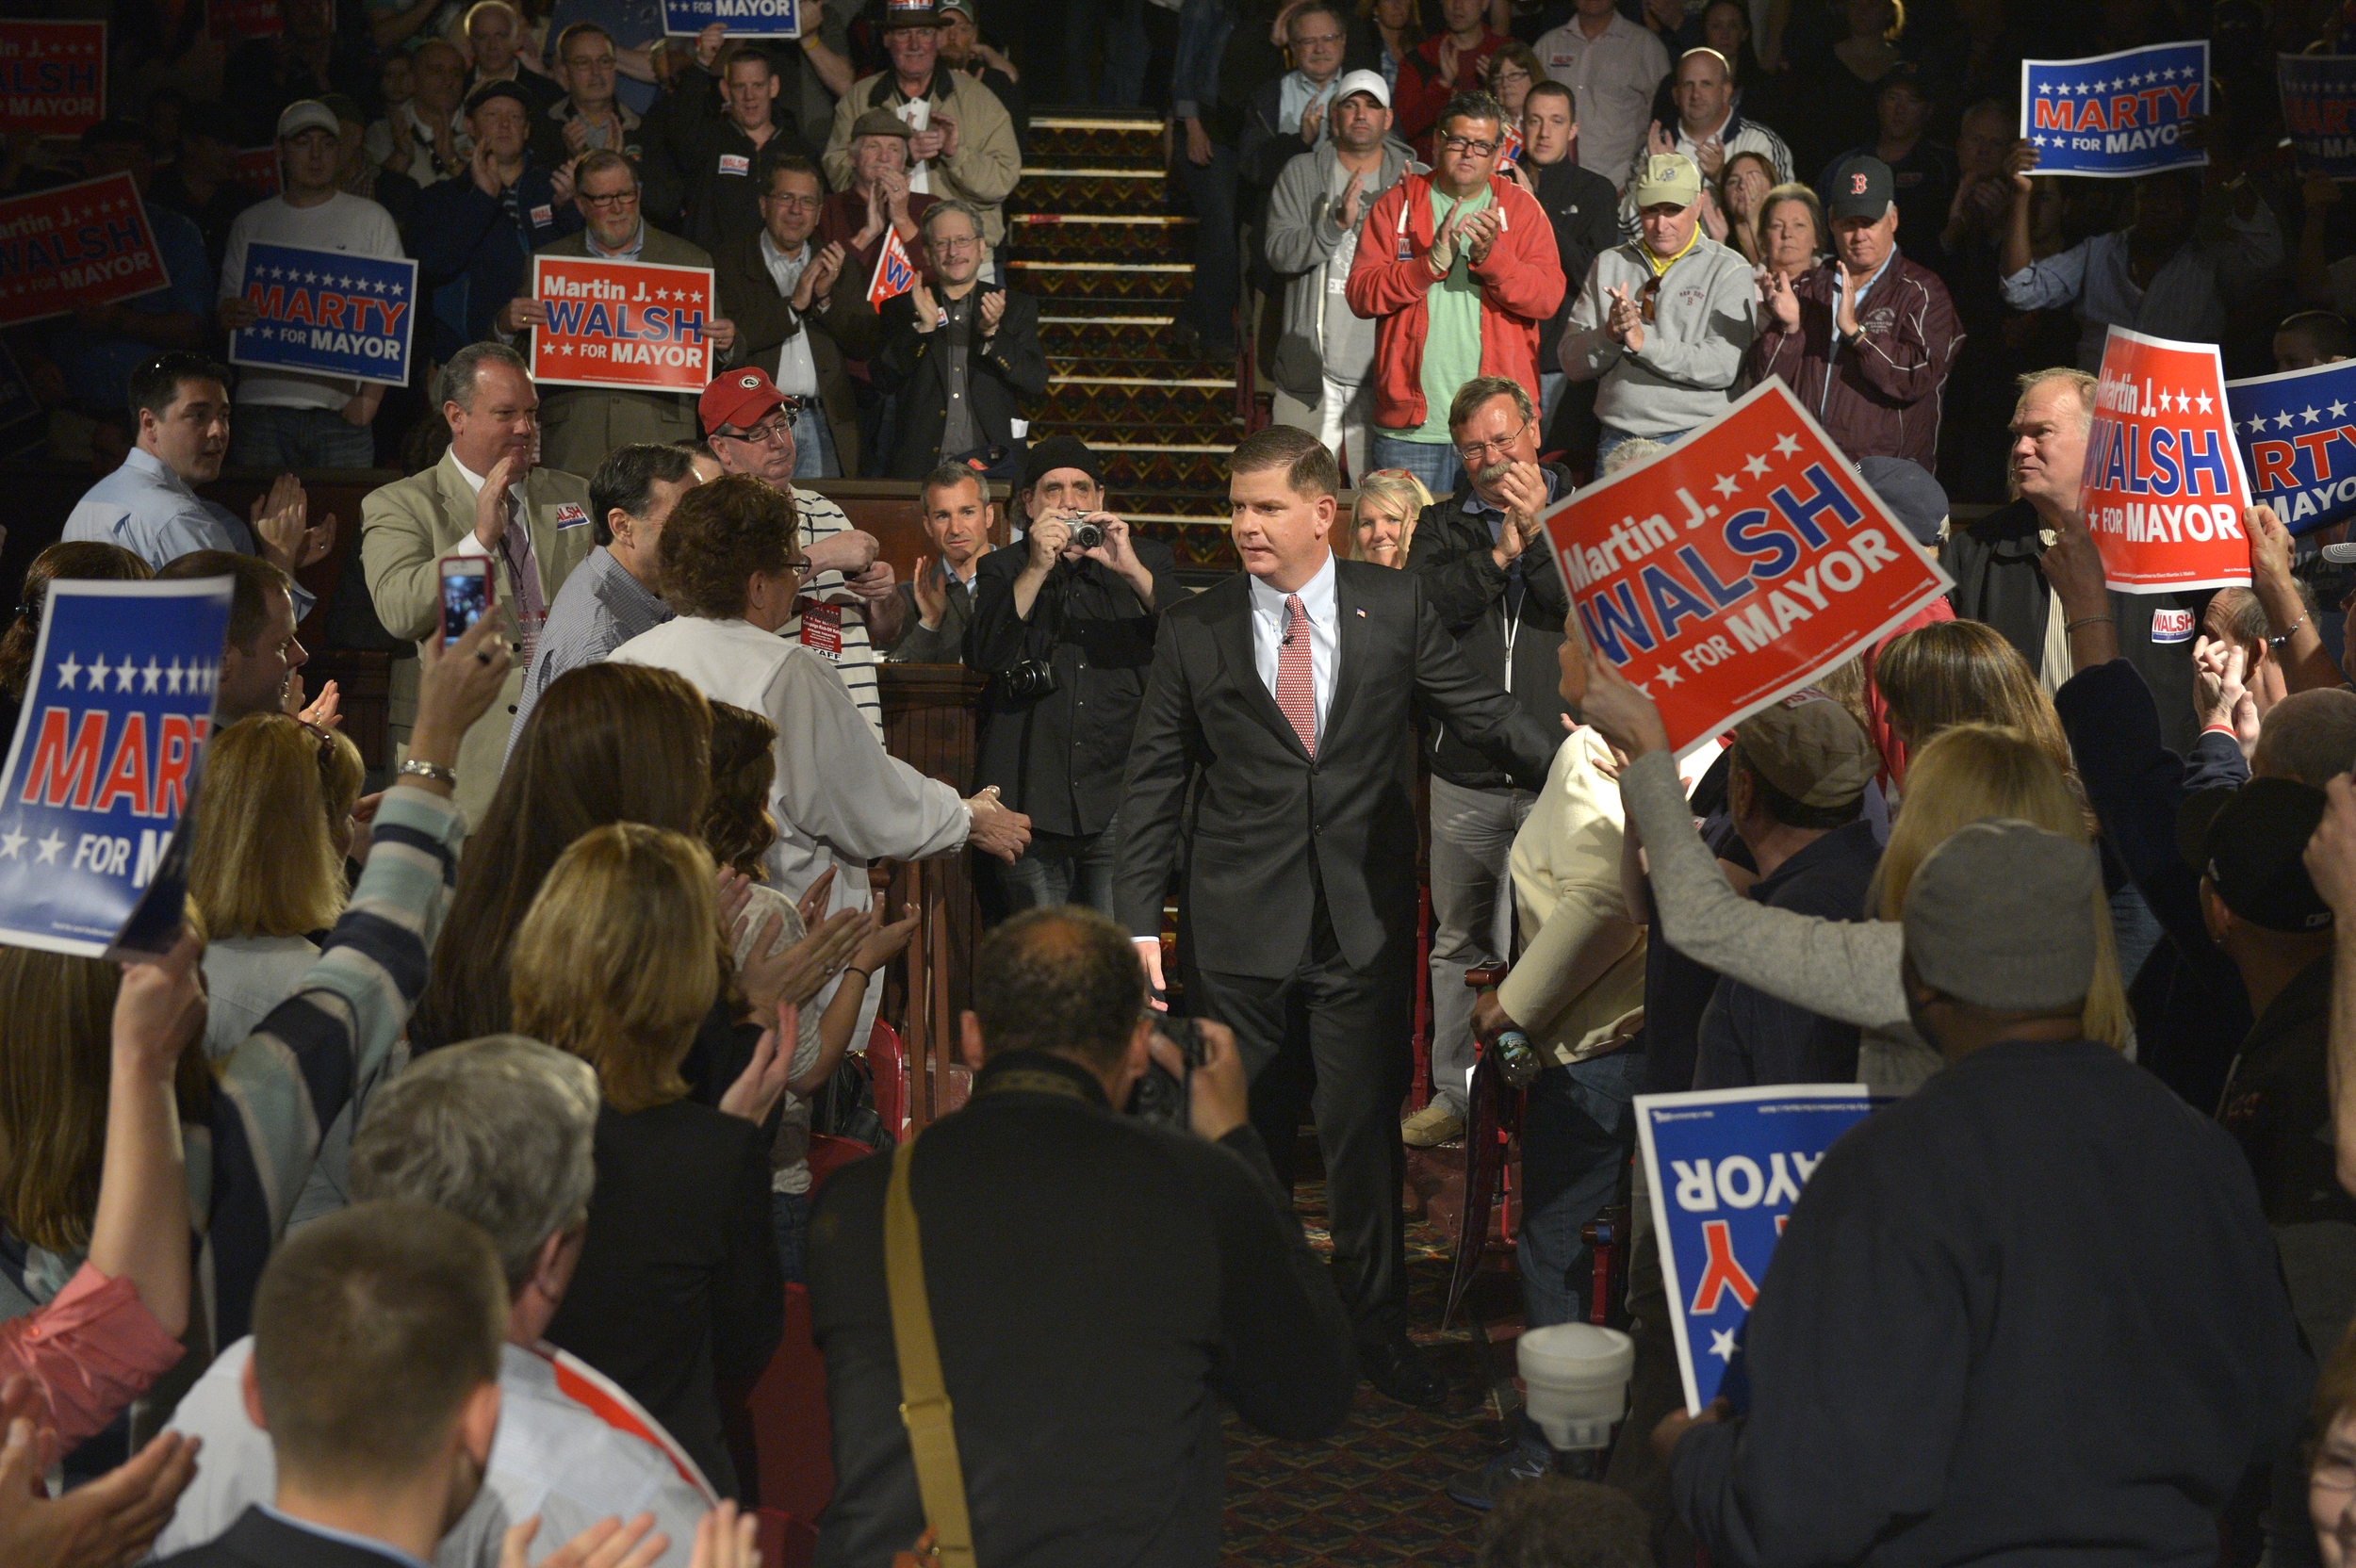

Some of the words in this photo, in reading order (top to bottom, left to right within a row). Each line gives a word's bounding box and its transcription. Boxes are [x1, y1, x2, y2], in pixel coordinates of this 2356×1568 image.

[690, 1, 713, 14] FOR
[715, 0, 791, 17] MAYOR
[8, 96, 95, 116] MAYOR
[2034, 83, 2201, 132] MARTY
[2071, 137, 2102, 152] FOR
[1851, 173, 1868, 195] B
[59, 250, 154, 290] MAYOR
[544, 274, 627, 301] Martin
[631, 281, 652, 303] J.
[249, 282, 408, 337] MARTY
[542, 299, 705, 345] WALSH
[280, 326, 307, 346] FOR
[310, 328, 402, 362] MAYOR
[580, 343, 608, 358] FOR
[612, 342, 703, 368] MAYOR
[2096, 368, 2139, 415] Martin
[2140, 377, 2157, 417] J.
[2084, 417, 2232, 498] WALSH
[1562, 513, 1678, 593] Martin
[1675, 486, 1722, 530] J.
[2102, 506, 2124, 534] FOR
[2125, 501, 2244, 543] MAYOR
[1578, 461, 1866, 669] WALSH
[1679, 633, 1736, 674] FOR
[1724, 528, 1902, 654] MAYOR
[2153, 612, 2195, 632] WALSH
[72, 832, 131, 876] FOR
